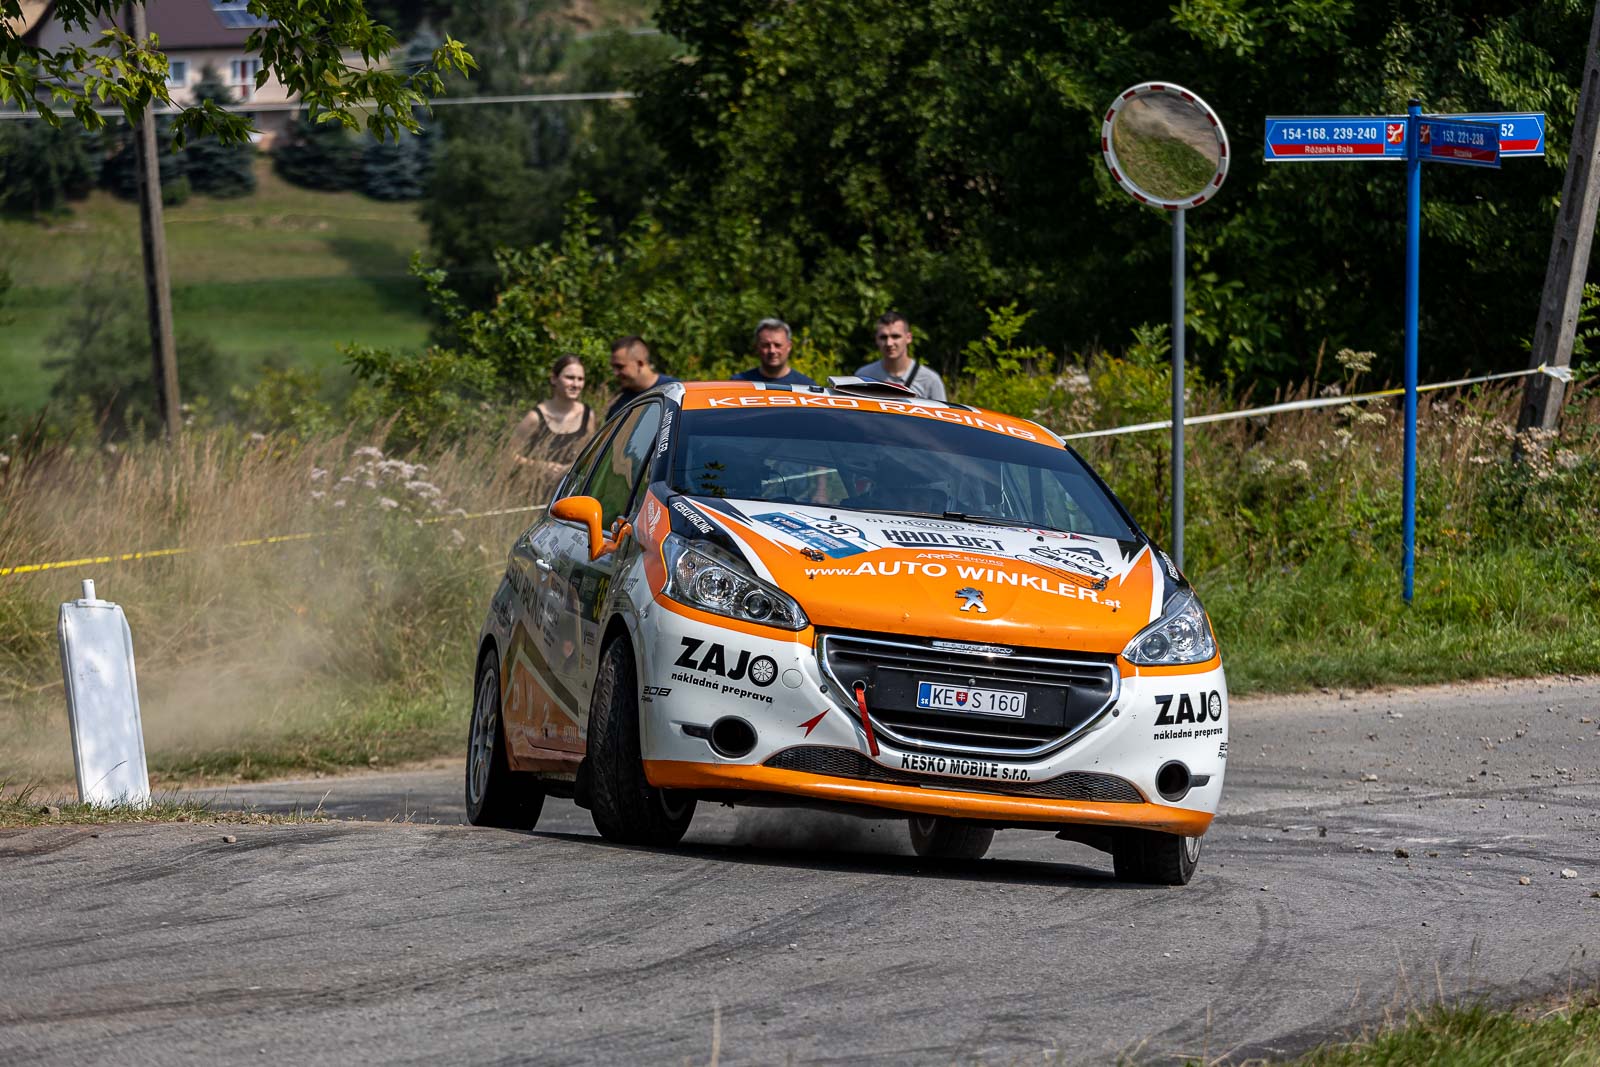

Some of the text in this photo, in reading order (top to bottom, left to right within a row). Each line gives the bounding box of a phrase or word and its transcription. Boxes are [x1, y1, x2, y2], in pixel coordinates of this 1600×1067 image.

[1333, 127, 1378, 140] 239-240
[708, 396, 1037, 441] KESKO RACING
[815, 521, 857, 536] 35
[955, 565, 1122, 610] WINKLER.at
[673, 636, 779, 688] ZAJO
[642, 685, 673, 697] 208
[671, 672, 774, 704] nákladná preprava
[932, 687, 1020, 713] KE S 160
[1153, 690, 1222, 726] ZAJO
[1153, 727, 1223, 741] nákladná preprava
[901, 753, 1031, 782] KESKO MOBILE s.r.o.
